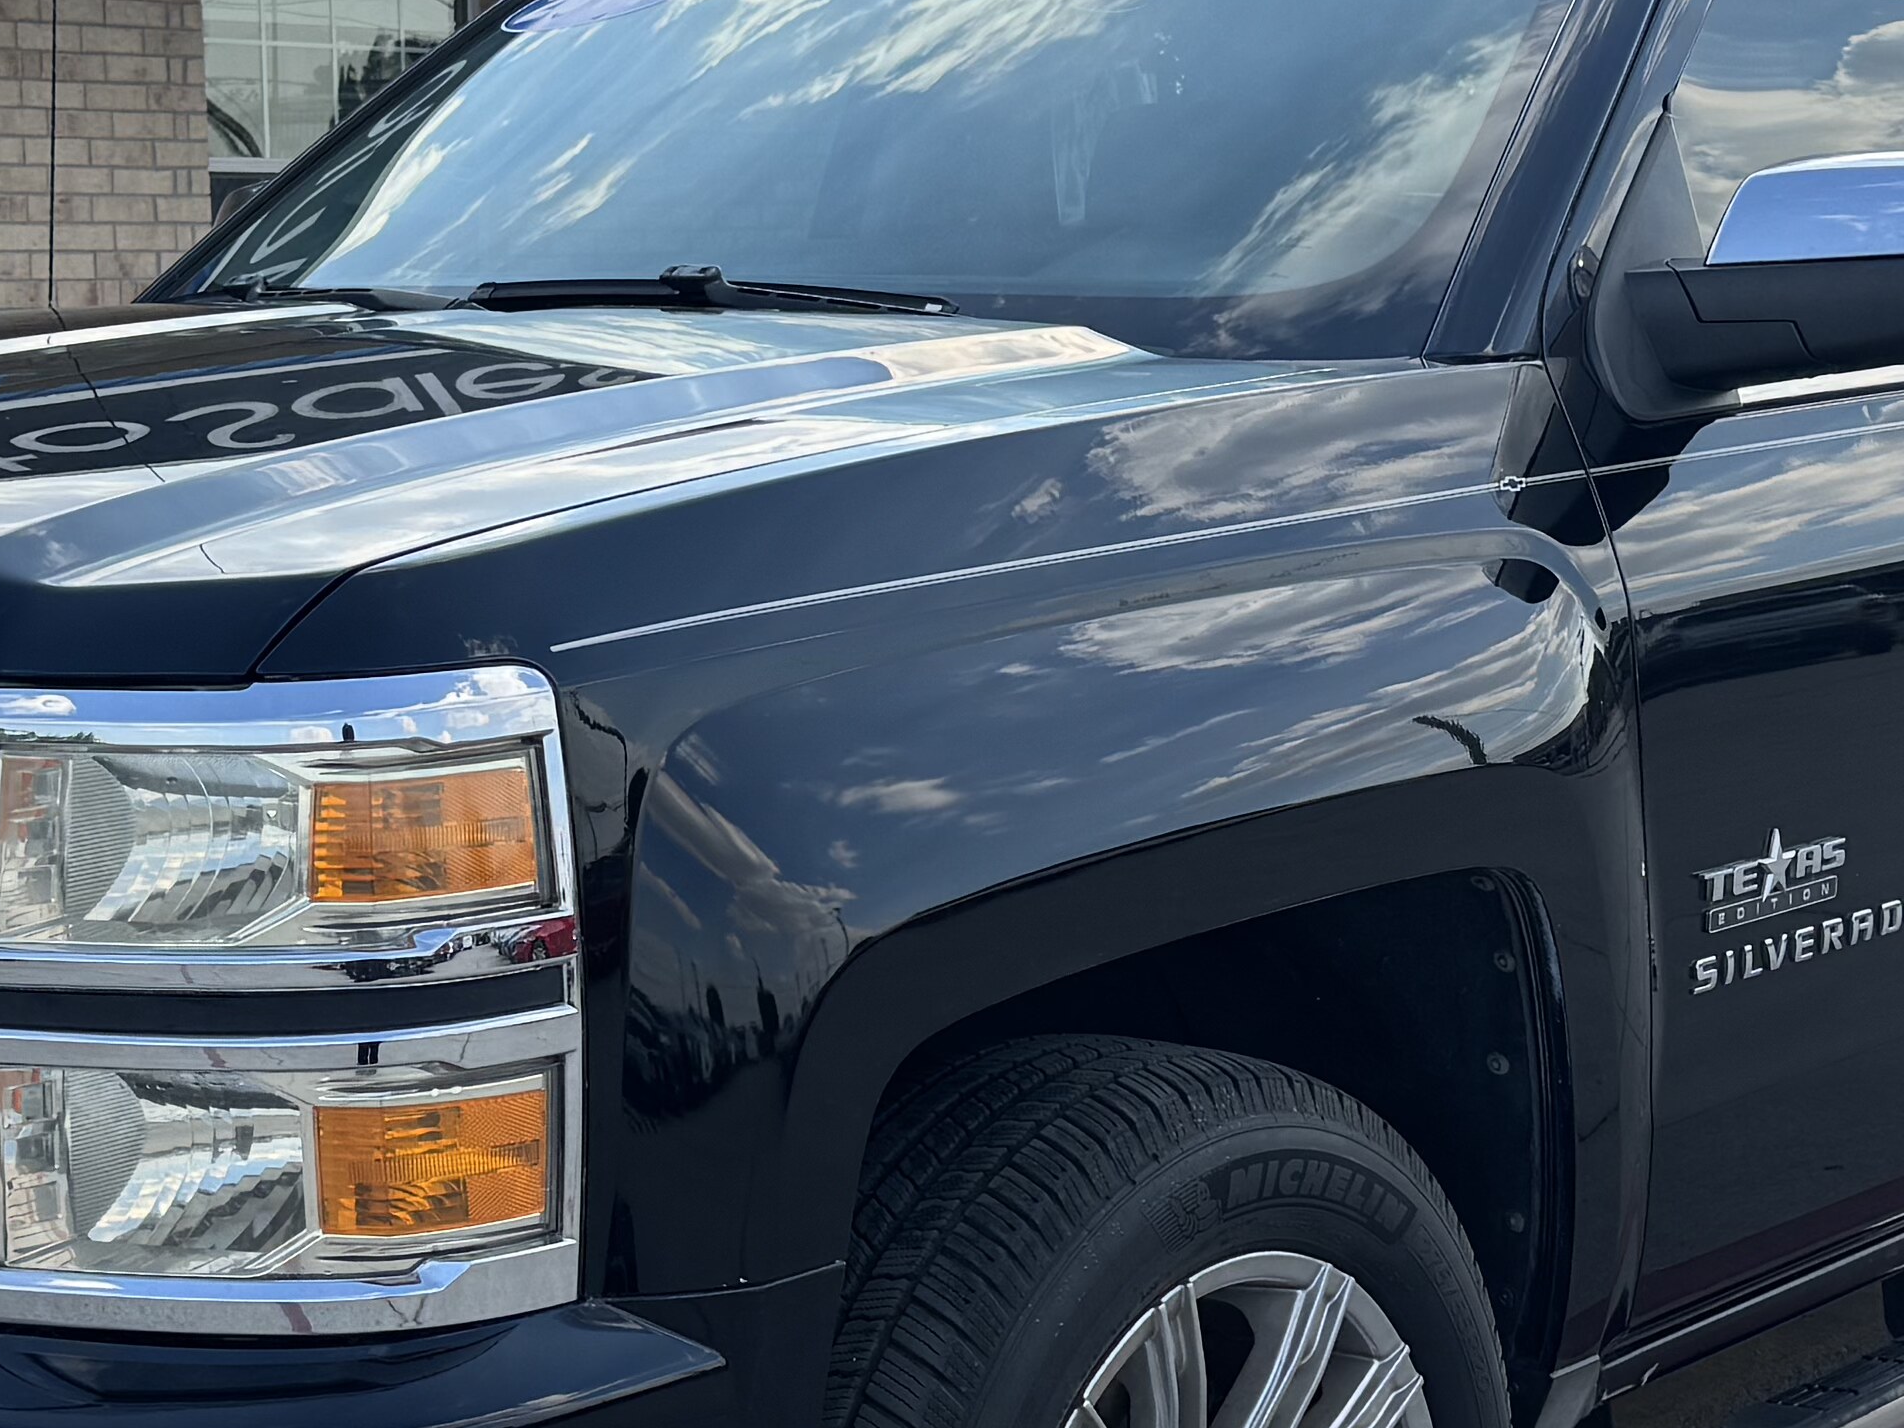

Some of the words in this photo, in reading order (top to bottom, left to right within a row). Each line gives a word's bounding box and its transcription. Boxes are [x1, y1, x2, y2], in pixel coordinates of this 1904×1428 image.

[1696, 828, 1846, 903] TEXAS
[1717, 882, 1830, 926] EDITION
[1227, 1158, 1411, 1234] MICHELIN
